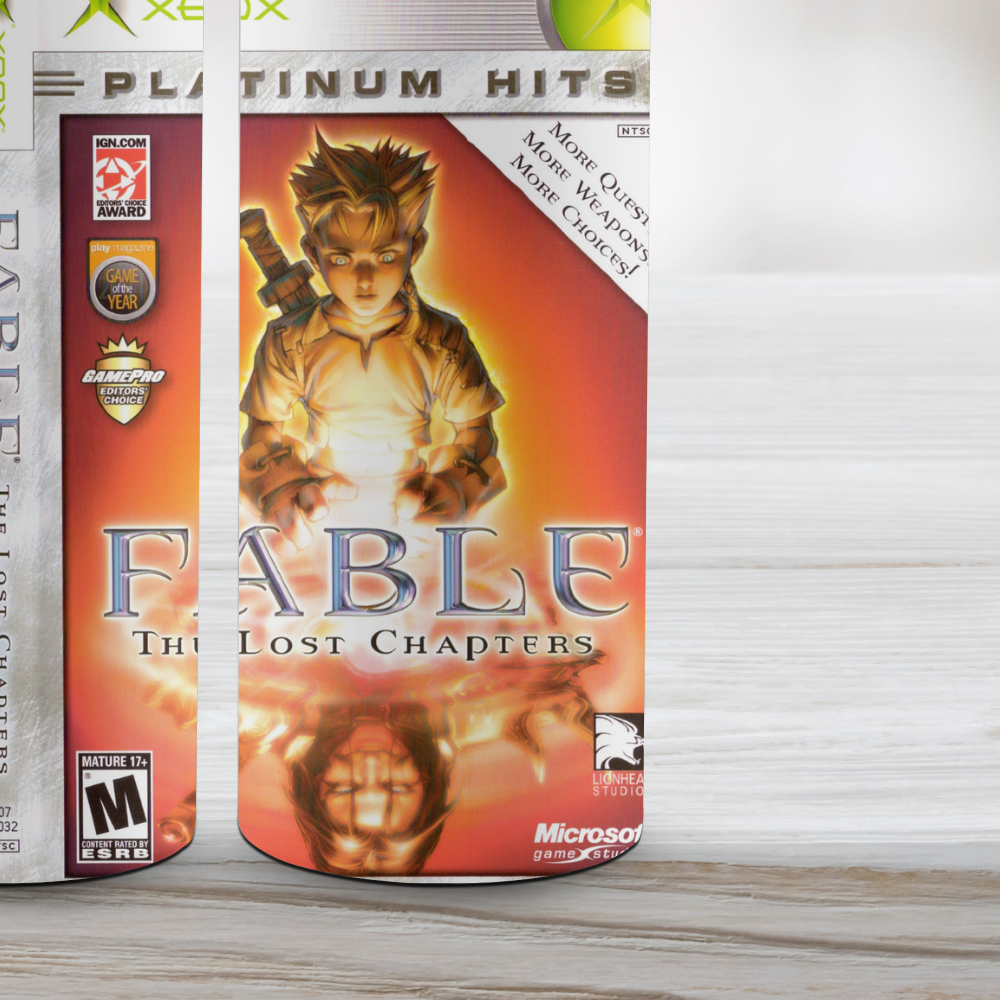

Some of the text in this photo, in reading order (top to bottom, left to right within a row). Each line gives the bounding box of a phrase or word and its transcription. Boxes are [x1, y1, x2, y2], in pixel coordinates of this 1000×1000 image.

[484, 69, 637, 99] HITS
[96, 138, 146, 148] IGN.COM
[548, 121, 649, 227] MORE QUEST
[522, 130, 649, 263] MORE WEAPONS
[97, 207, 146, 217] AWARD
[509, 153, 640, 279] MORE CHOICES!
[91, 243, 154, 253] play magazine
[106, 268, 139, 284] GAME
[112, 284, 133, 293] of the
[108, 294, 138, 309] YEAR
[100, 386, 149, 395] EDITORS'
[104, 396, 144, 405] CHOICE
[239, 629, 594, 661] LOST CHAPTERS
[82, 756, 147, 767] MATURE 17+
[85, 774, 147, 835] M
[82, 849, 148, 858] ESRB
[534, 849, 576, 861] game
